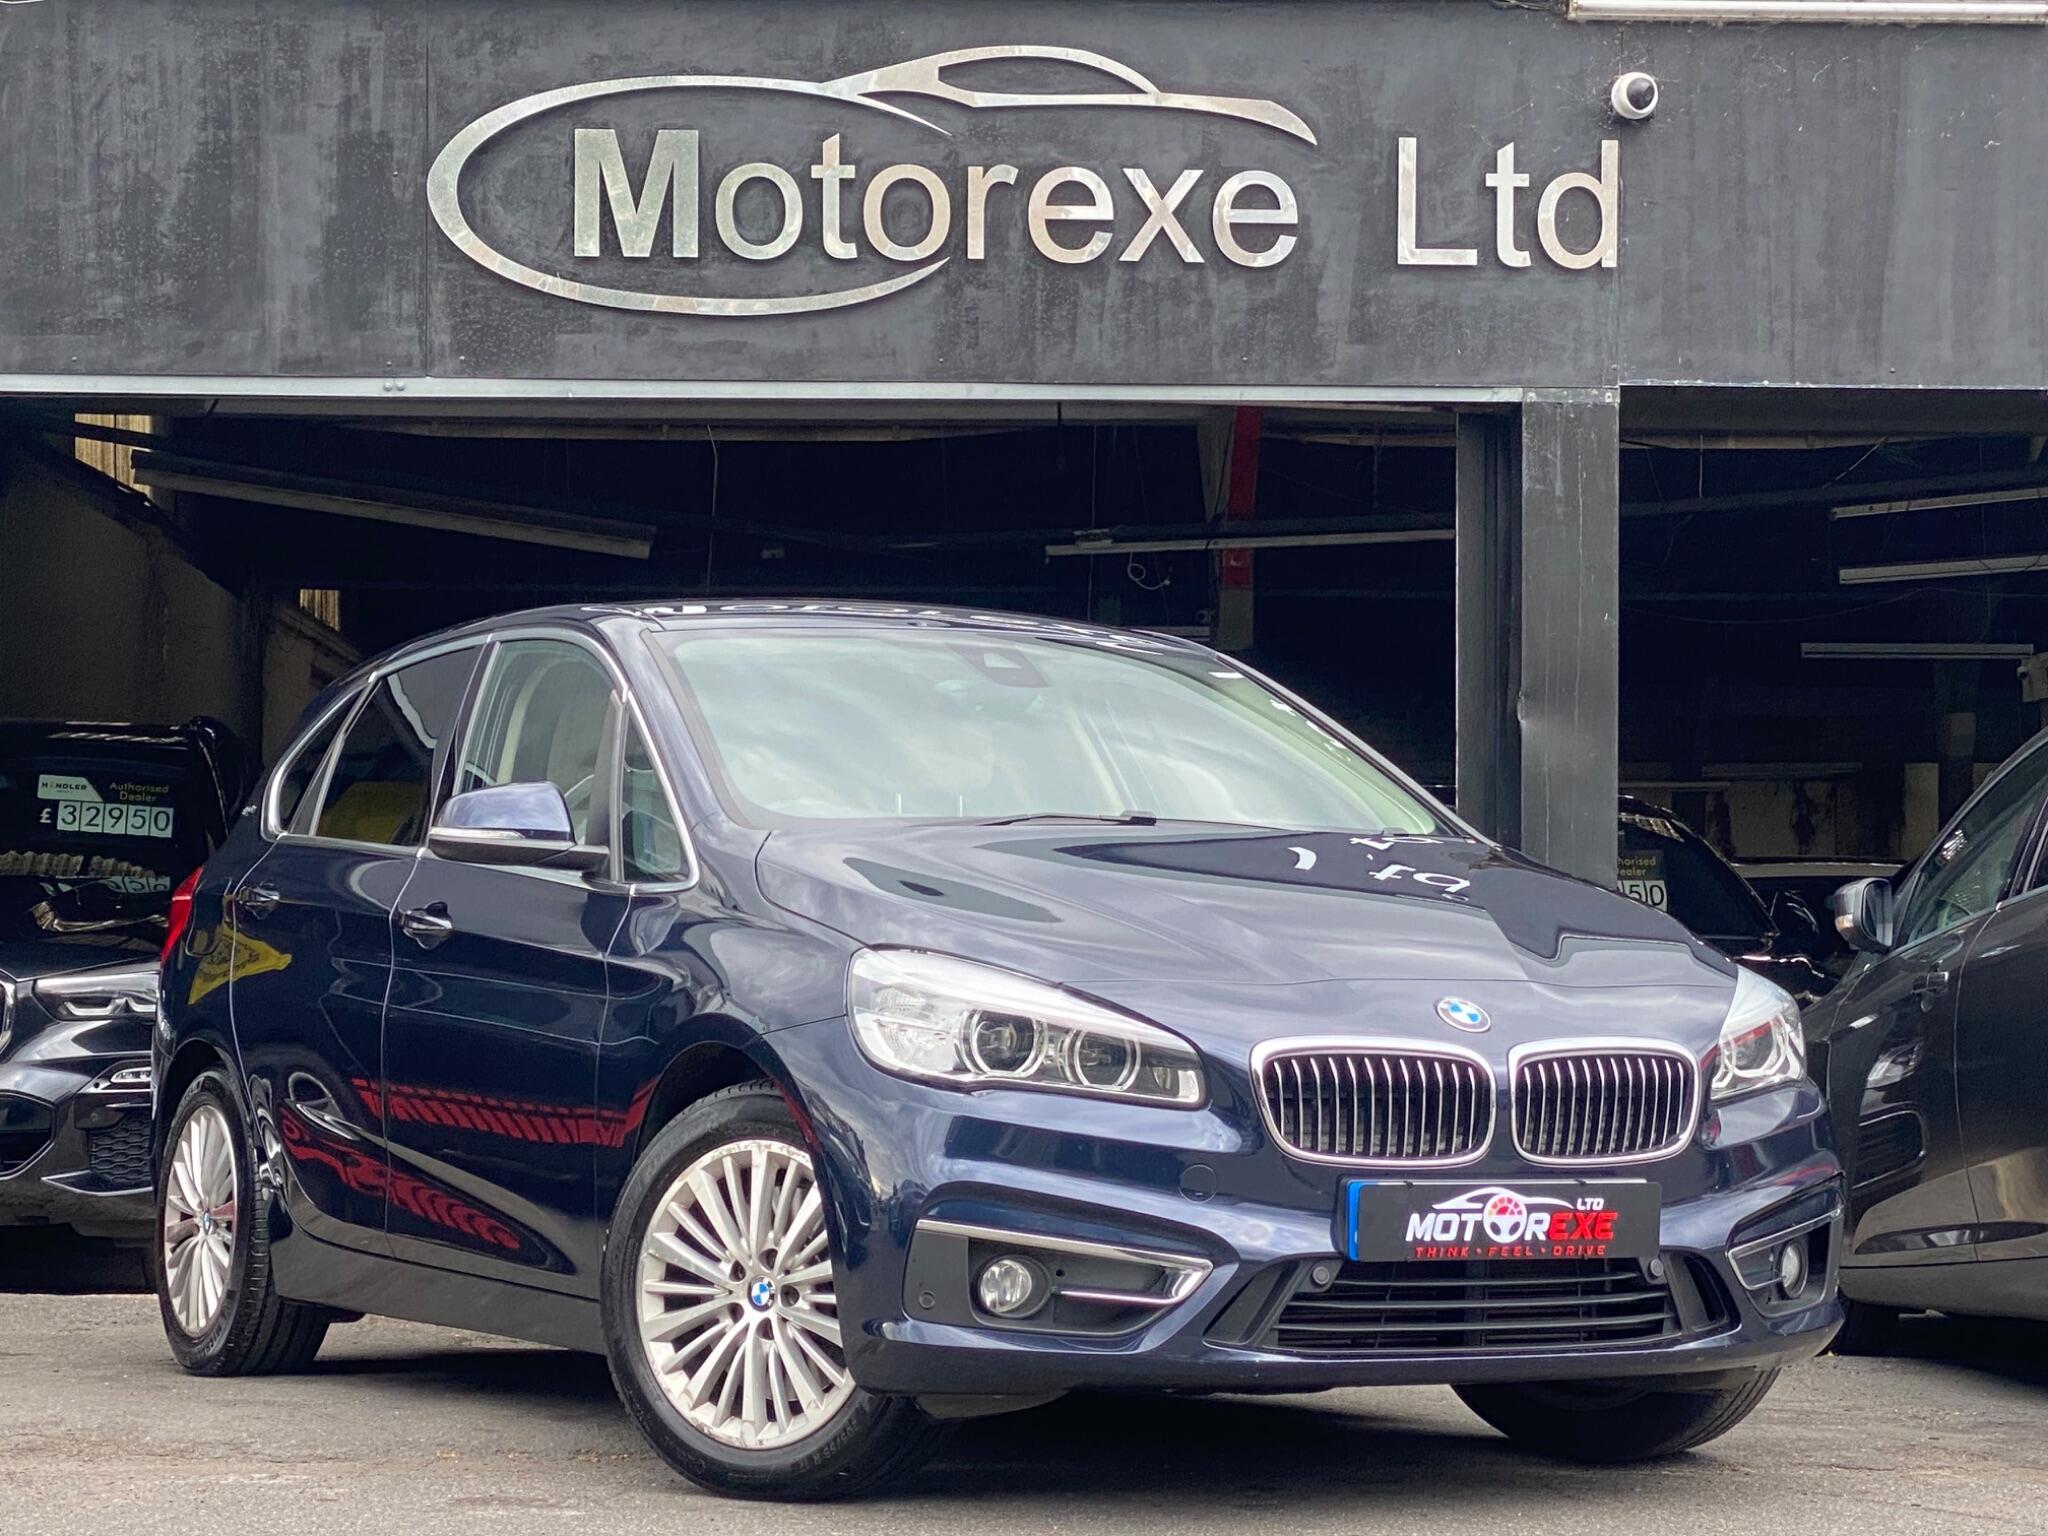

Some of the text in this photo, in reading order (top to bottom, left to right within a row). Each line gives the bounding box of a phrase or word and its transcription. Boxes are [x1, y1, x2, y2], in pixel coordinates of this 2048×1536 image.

[570, 127, 1621, 271] Motorexe Ltd
[109, 782, 169, 793] Authorised
[120, 791, 157, 802] Dealer
[1617, 856, 1656, 866] horised
[1617, 884, 1665, 906] 50
[1576, 1198, 1605, 1211] LTD
[1405, 1194, 1618, 1244] MOTOREXE
[1415, 1245, 1606, 1258] THINK FEEL DRIVE
